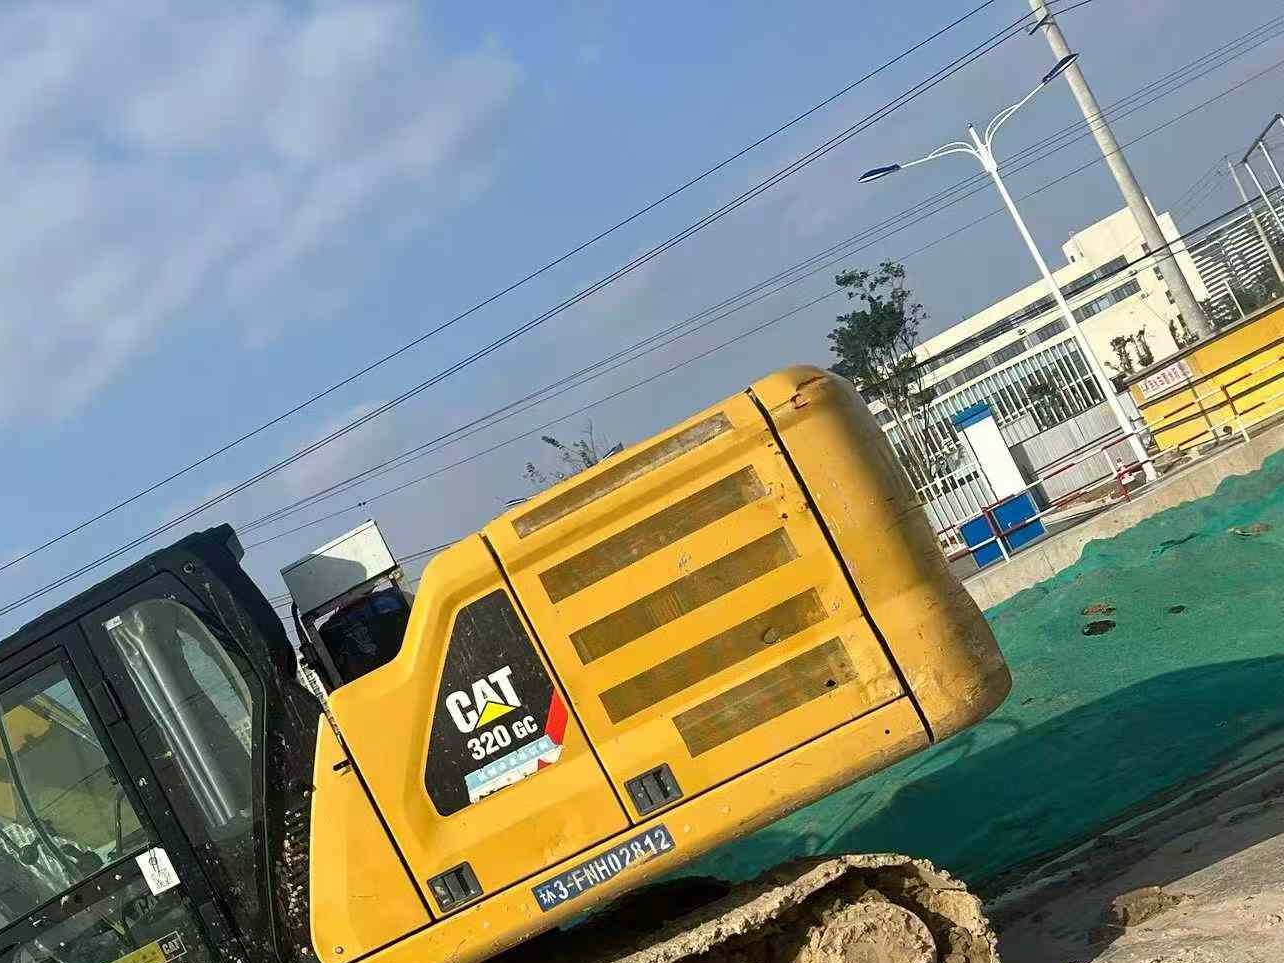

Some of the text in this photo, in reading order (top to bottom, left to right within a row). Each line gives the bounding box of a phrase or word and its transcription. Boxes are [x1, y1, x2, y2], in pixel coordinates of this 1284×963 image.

[445, 665, 522, 734] CAT
[467, 724, 511, 760] 320
[512, 715, 538, 739] GC
[162, 938, 180, 955] CAT
